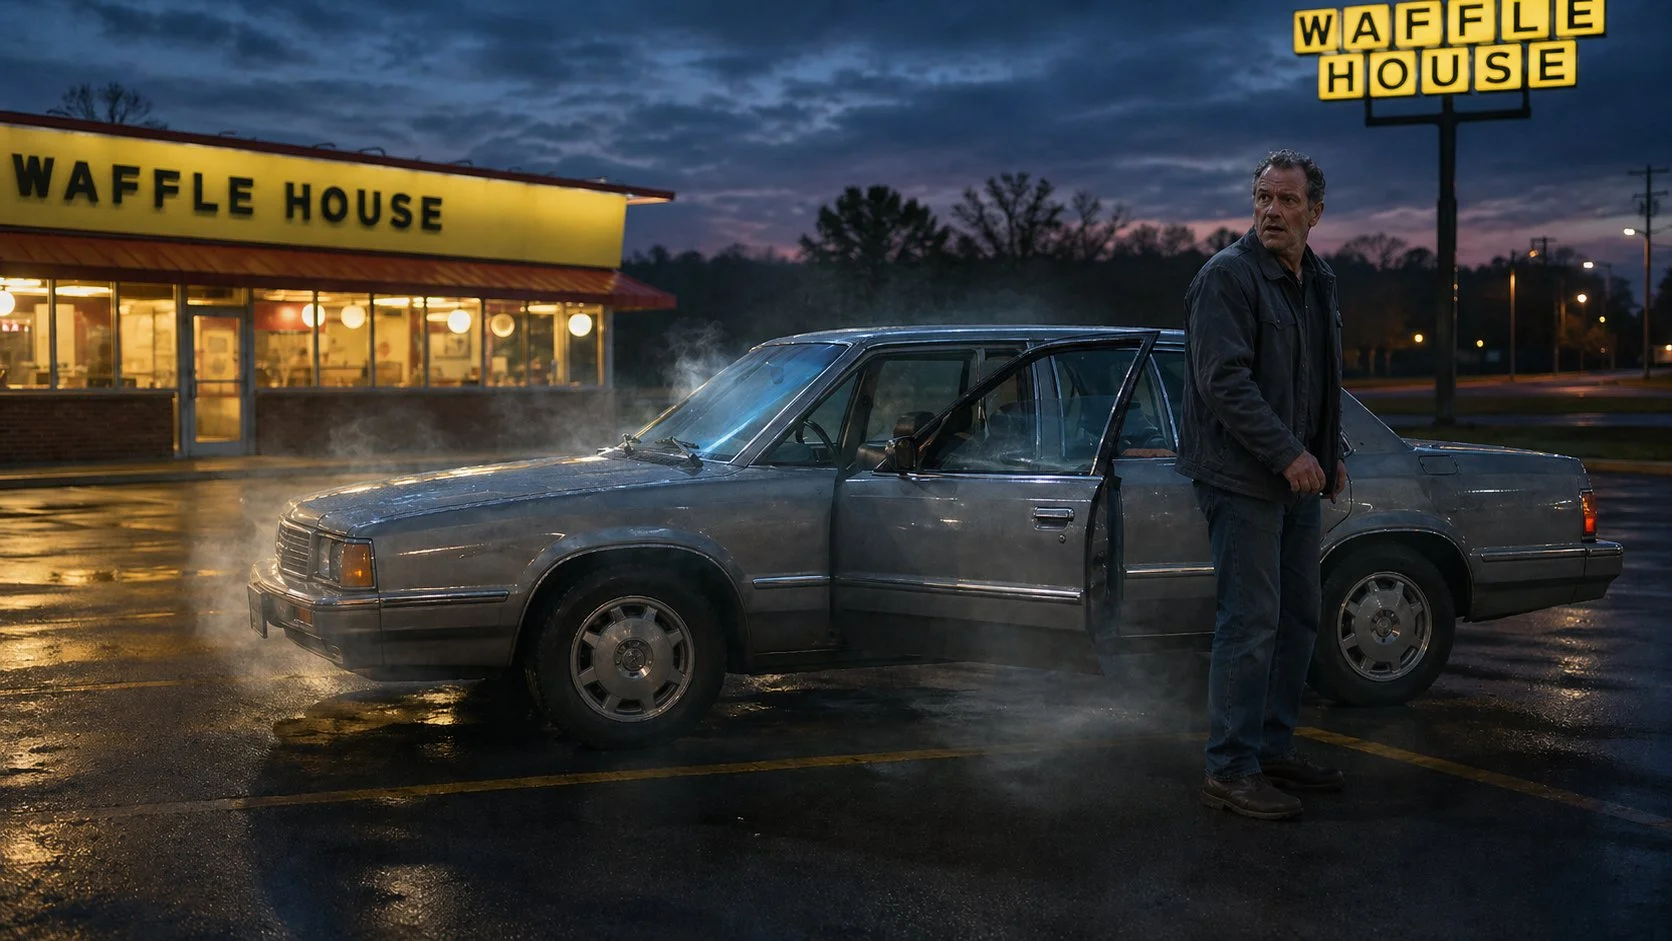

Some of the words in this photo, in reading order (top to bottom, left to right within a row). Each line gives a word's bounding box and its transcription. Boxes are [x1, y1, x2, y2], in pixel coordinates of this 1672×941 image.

[1299, 0, 1593, 46] WAFFLE
[1328, 48, 1565, 93] HOUSE
[12, 153, 254, 216] WAFFLE
[285, 182, 443, 231] HOUSE
